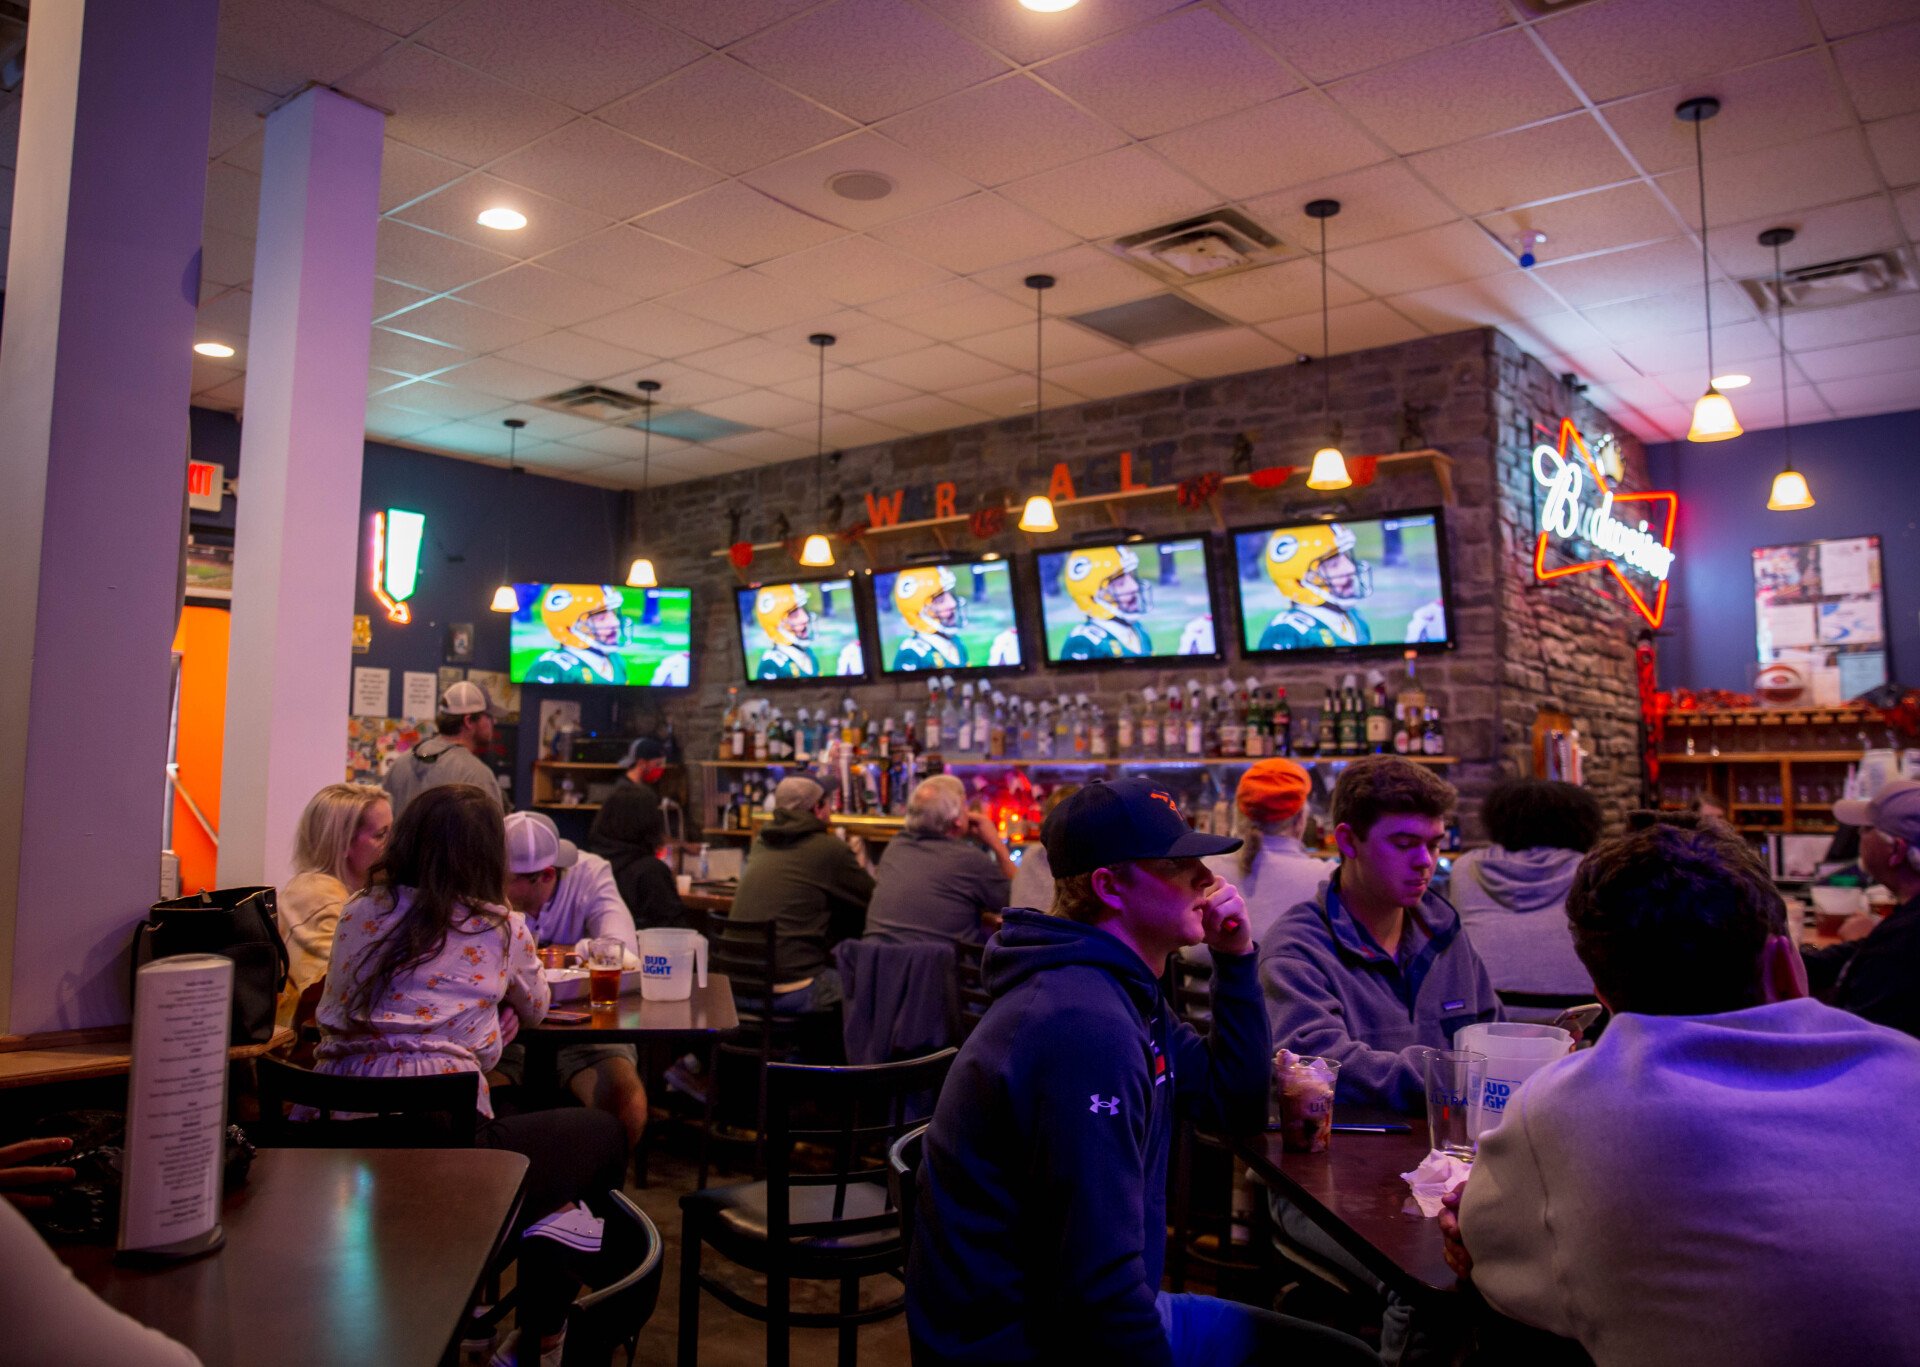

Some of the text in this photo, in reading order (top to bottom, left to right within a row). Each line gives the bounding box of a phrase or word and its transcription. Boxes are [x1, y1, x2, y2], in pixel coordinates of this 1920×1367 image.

[644, 955, 668, 966] BUD
[642, 964, 672, 976] LIGHT
[1485, 1081, 1510, 1097] UD
